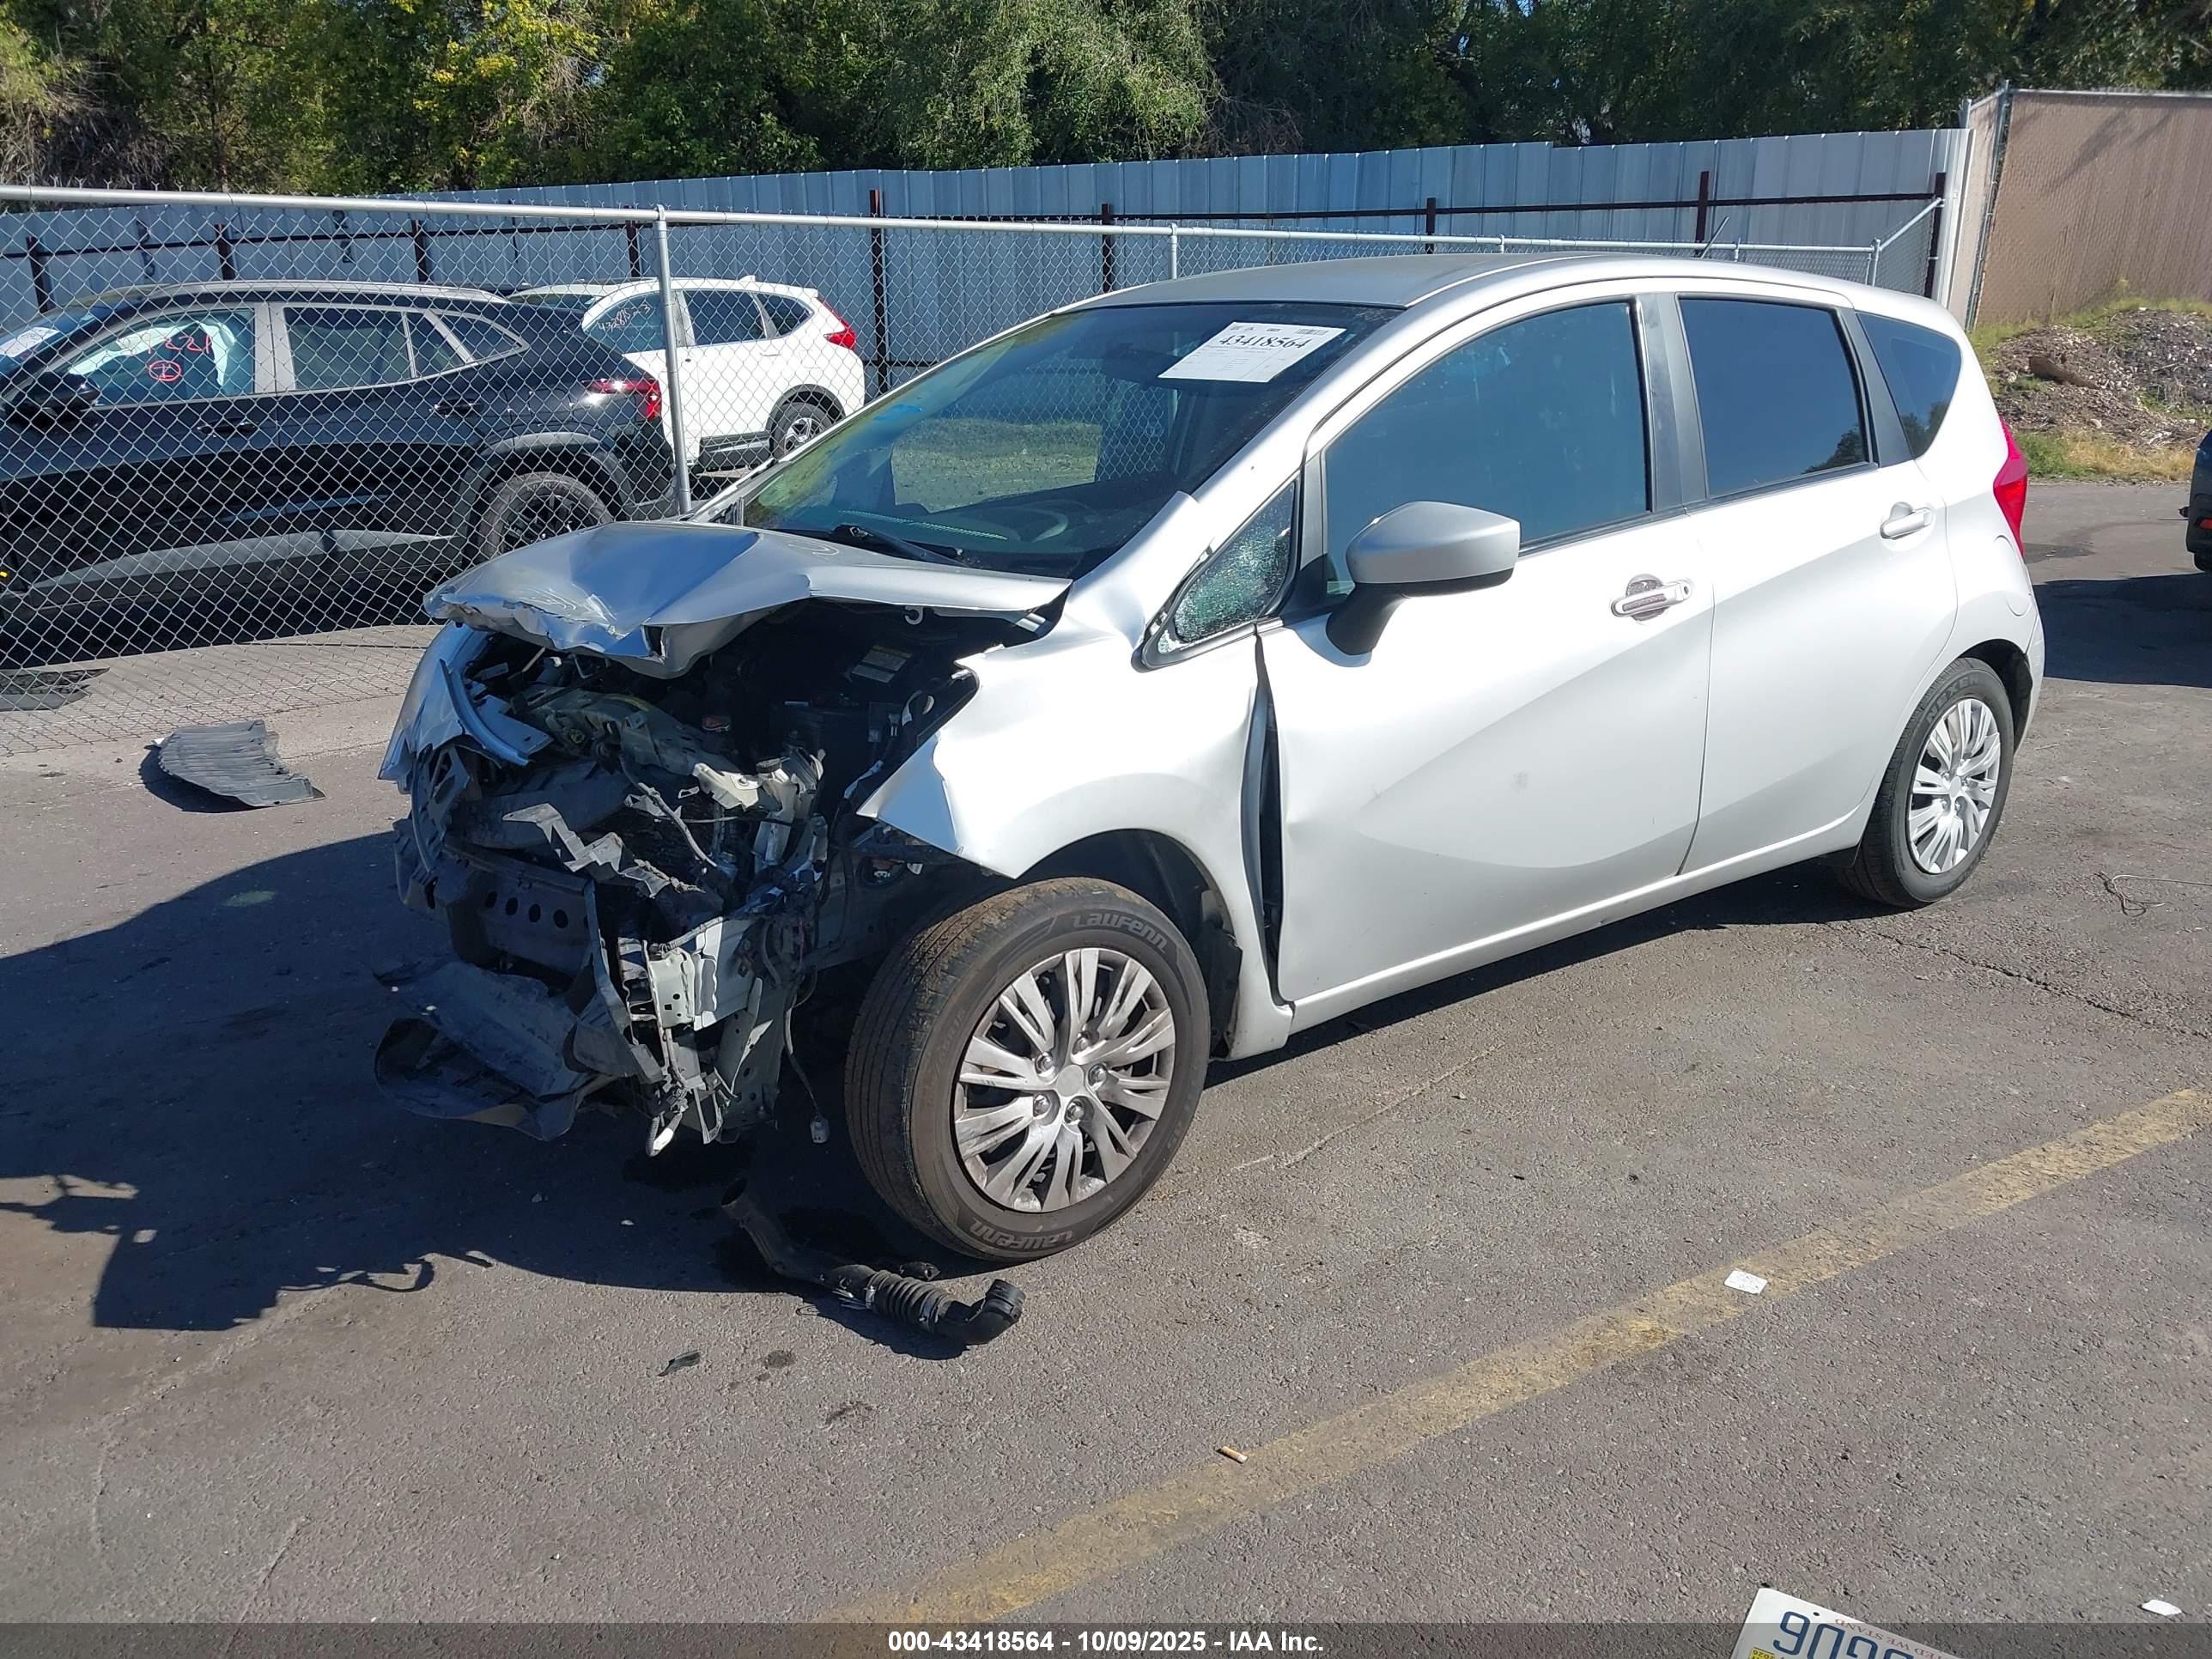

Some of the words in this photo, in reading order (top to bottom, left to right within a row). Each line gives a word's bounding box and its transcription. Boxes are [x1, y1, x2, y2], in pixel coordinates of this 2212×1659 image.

[1219, 335, 1312, 349] 43418564
[1927, 673, 1979, 724] NEXEN
[1835, 1618, 1885, 1641] STAND
[1887, 1637, 1910, 1650] WE
